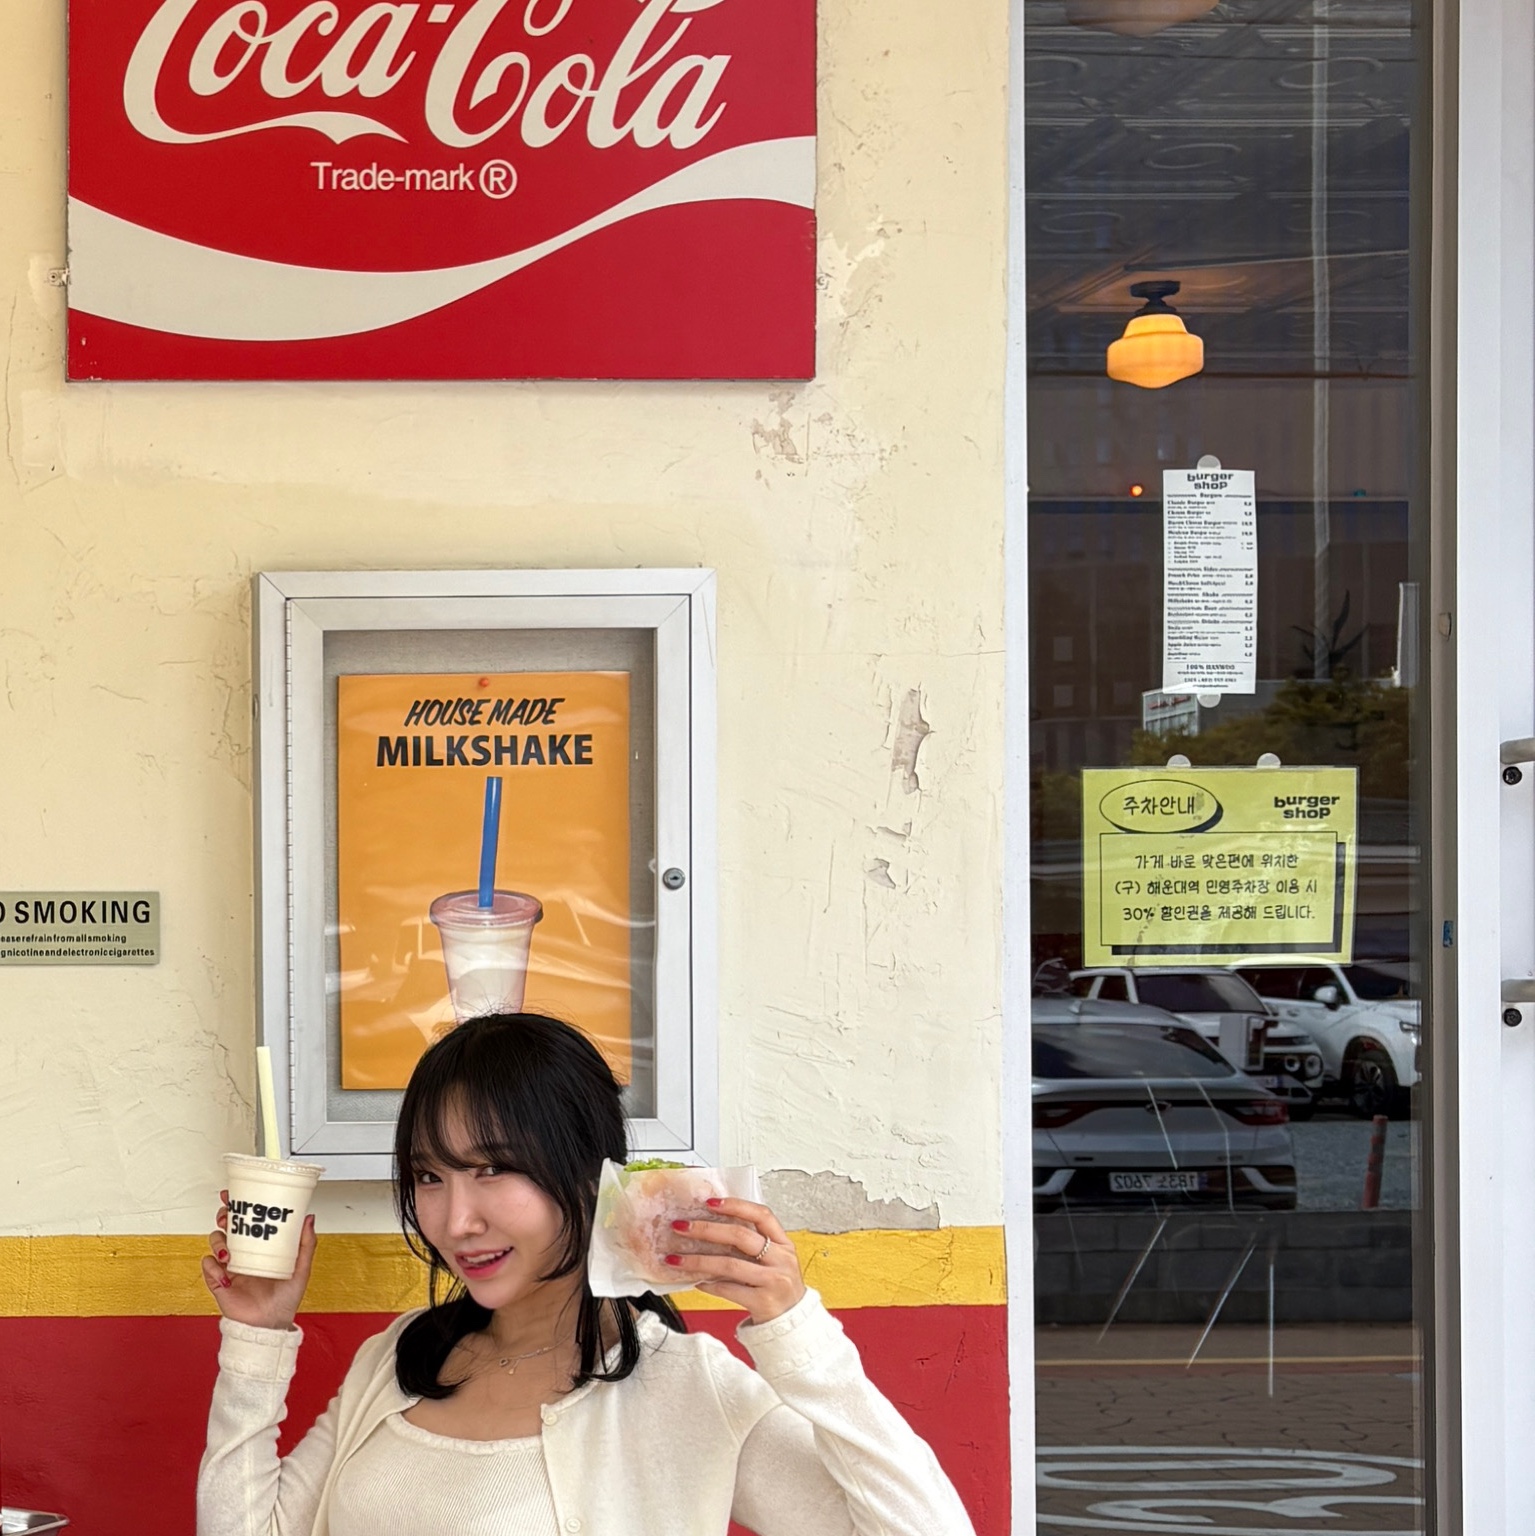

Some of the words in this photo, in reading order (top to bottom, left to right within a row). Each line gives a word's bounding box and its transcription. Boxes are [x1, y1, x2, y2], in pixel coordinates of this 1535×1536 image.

[122, 0, 733, 149] Coca-Cola
[1187, 473, 1234, 482] burger
[1194, 481, 1228, 490] shop
[404, 697, 490, 727] HOUSE
[487, 697, 566, 726] MADE
[376, 733, 593, 768] MILKSHAKE
[1123, 795, 1196, 816] 주차안내
[1274, 795, 1340, 808] burger
[1283, 806, 1331, 819] shop
[1135, 854, 1164, 869] 가게
[1170, 854, 1196, 869] 바로
[1261, 854, 1299, 868] 위치한
[1115, 880, 1141, 895] (구)
[1147, 880, 1200, 895] 해운대역
[1206, 879, 1270, 894] 민영주차장
[1276, 879, 1300, 893] 이용
[1306, 879, 1317, 893] 시
[14, 900, 150, 924] SMOKING
[1123, 907, 1155, 921] 30%
[1161, 905, 1212, 921] 할인권을
[1218, 905, 1257, 920] 제공해
